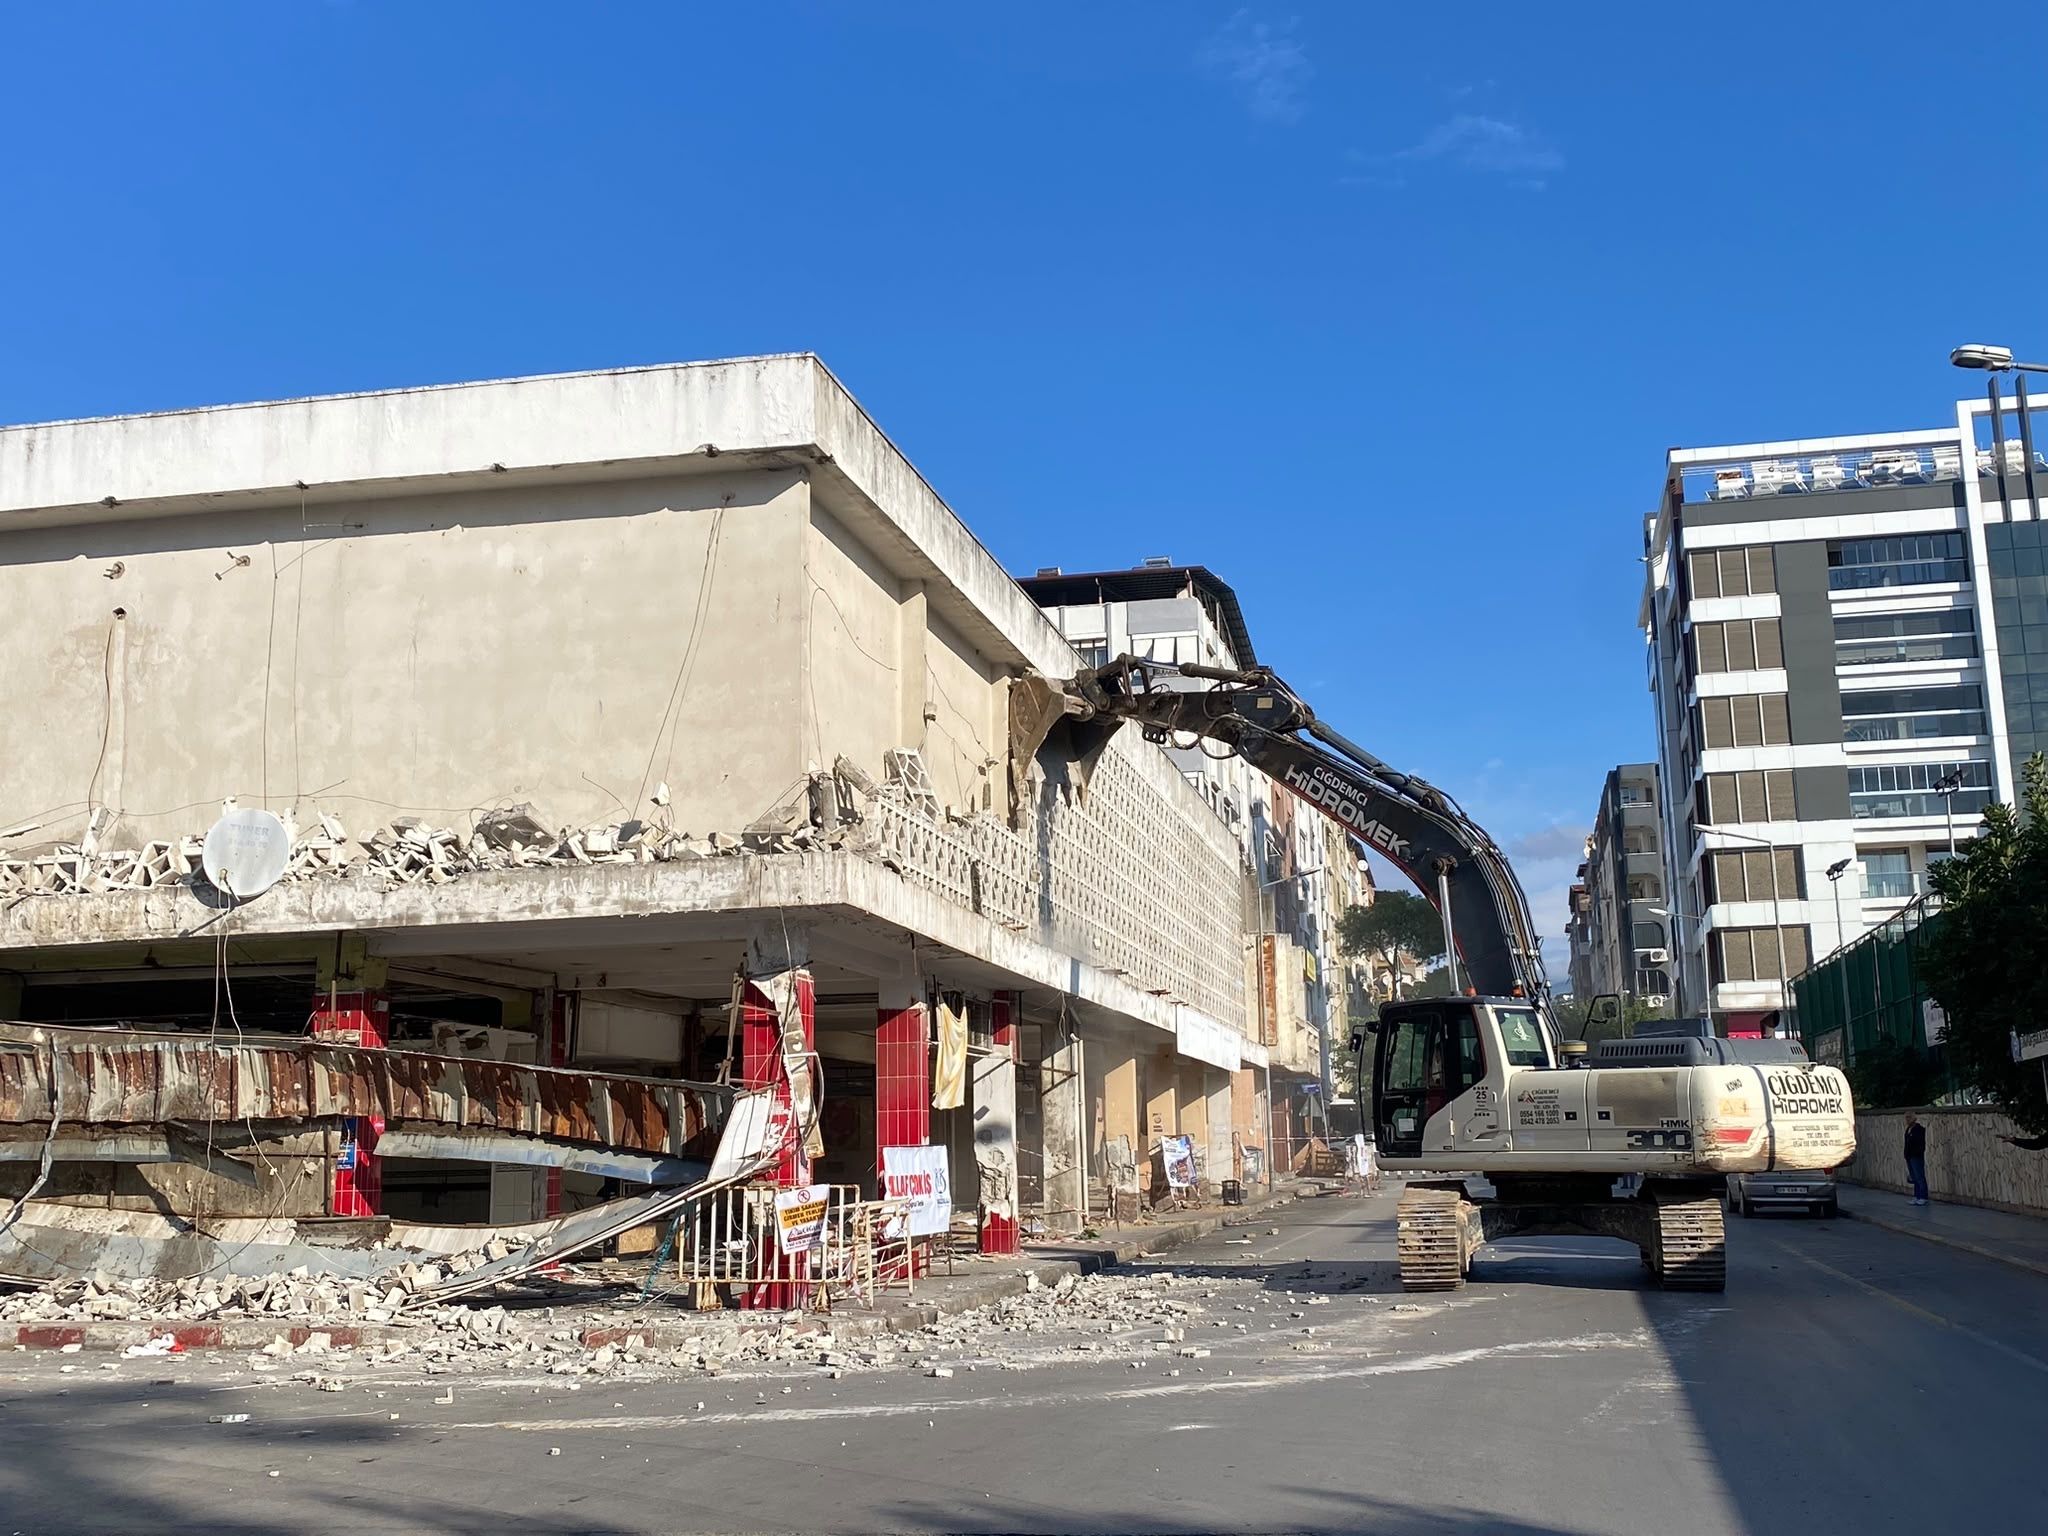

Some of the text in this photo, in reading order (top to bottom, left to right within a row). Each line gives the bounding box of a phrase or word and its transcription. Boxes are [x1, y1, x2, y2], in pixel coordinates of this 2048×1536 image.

[1767, 1070, 1842, 1101] ÇİĞDEMCİ
[1475, 1091, 1487, 1100] 25
[1660, 1120, 1690, 1128] HMK
[1627, 1130, 1692, 1150] 300
